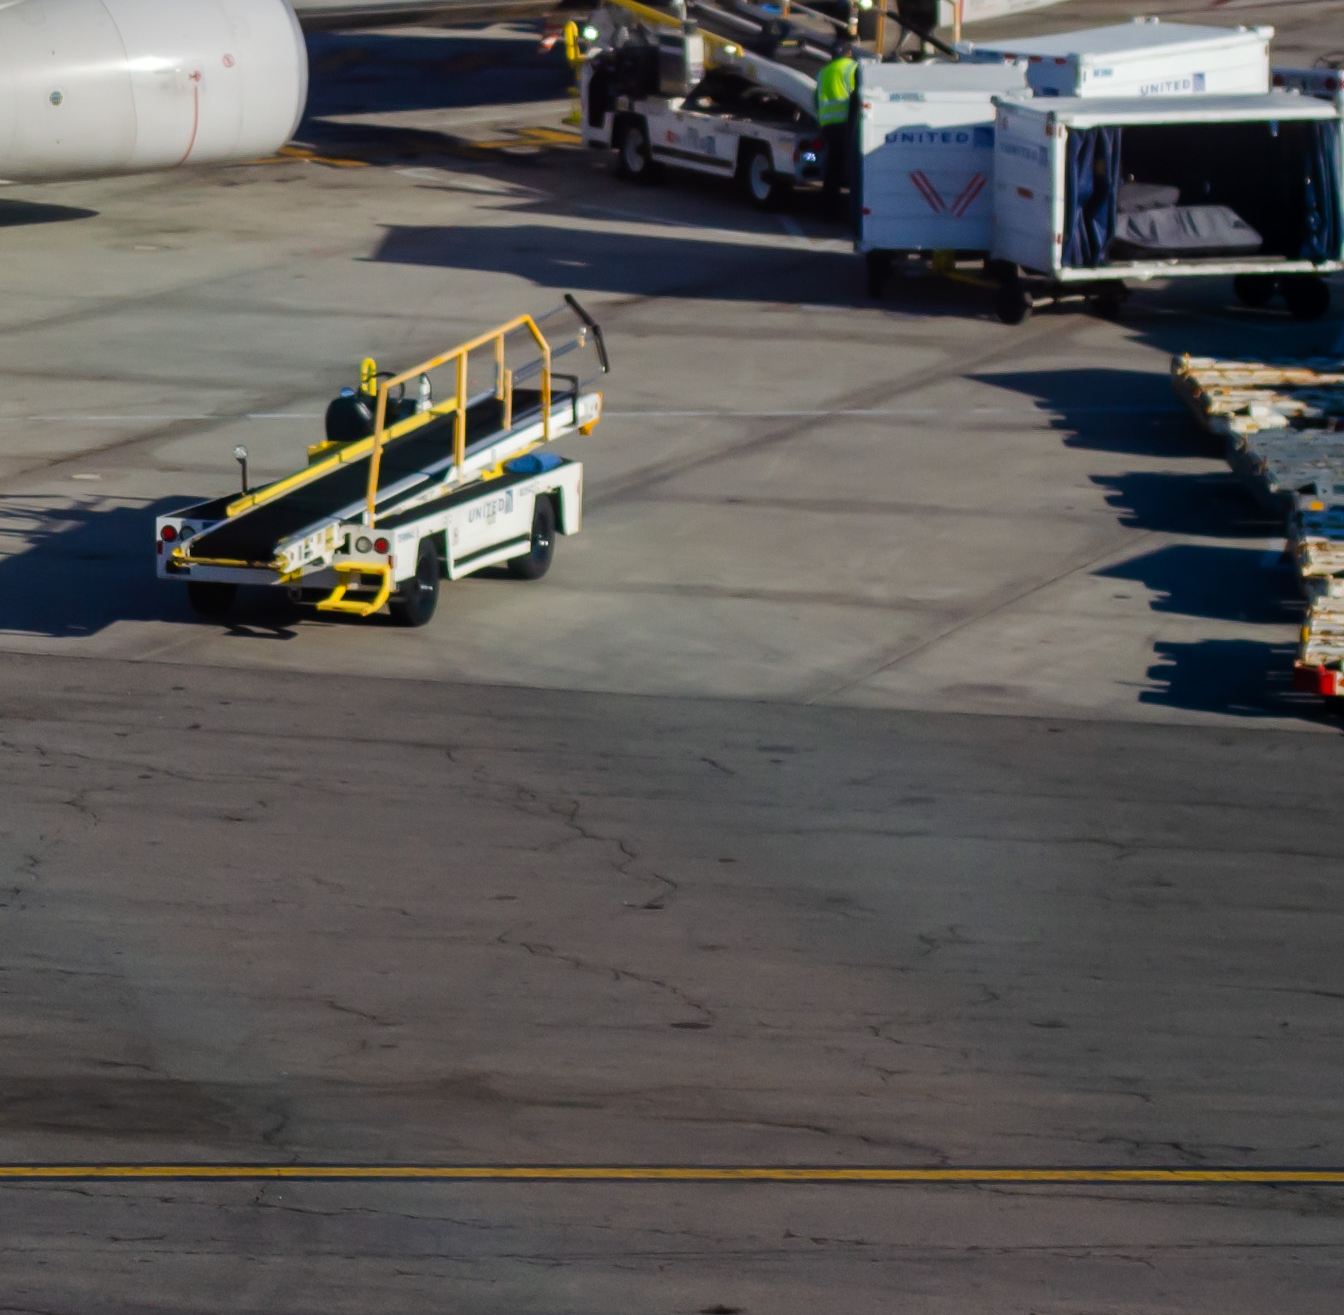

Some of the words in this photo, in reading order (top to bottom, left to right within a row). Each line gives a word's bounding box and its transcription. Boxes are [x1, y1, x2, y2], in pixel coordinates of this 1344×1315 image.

[1140, 79, 1192, 96] UNITED
[885, 131, 970, 145] UNITED
[468, 498, 505, 523] UNITED
